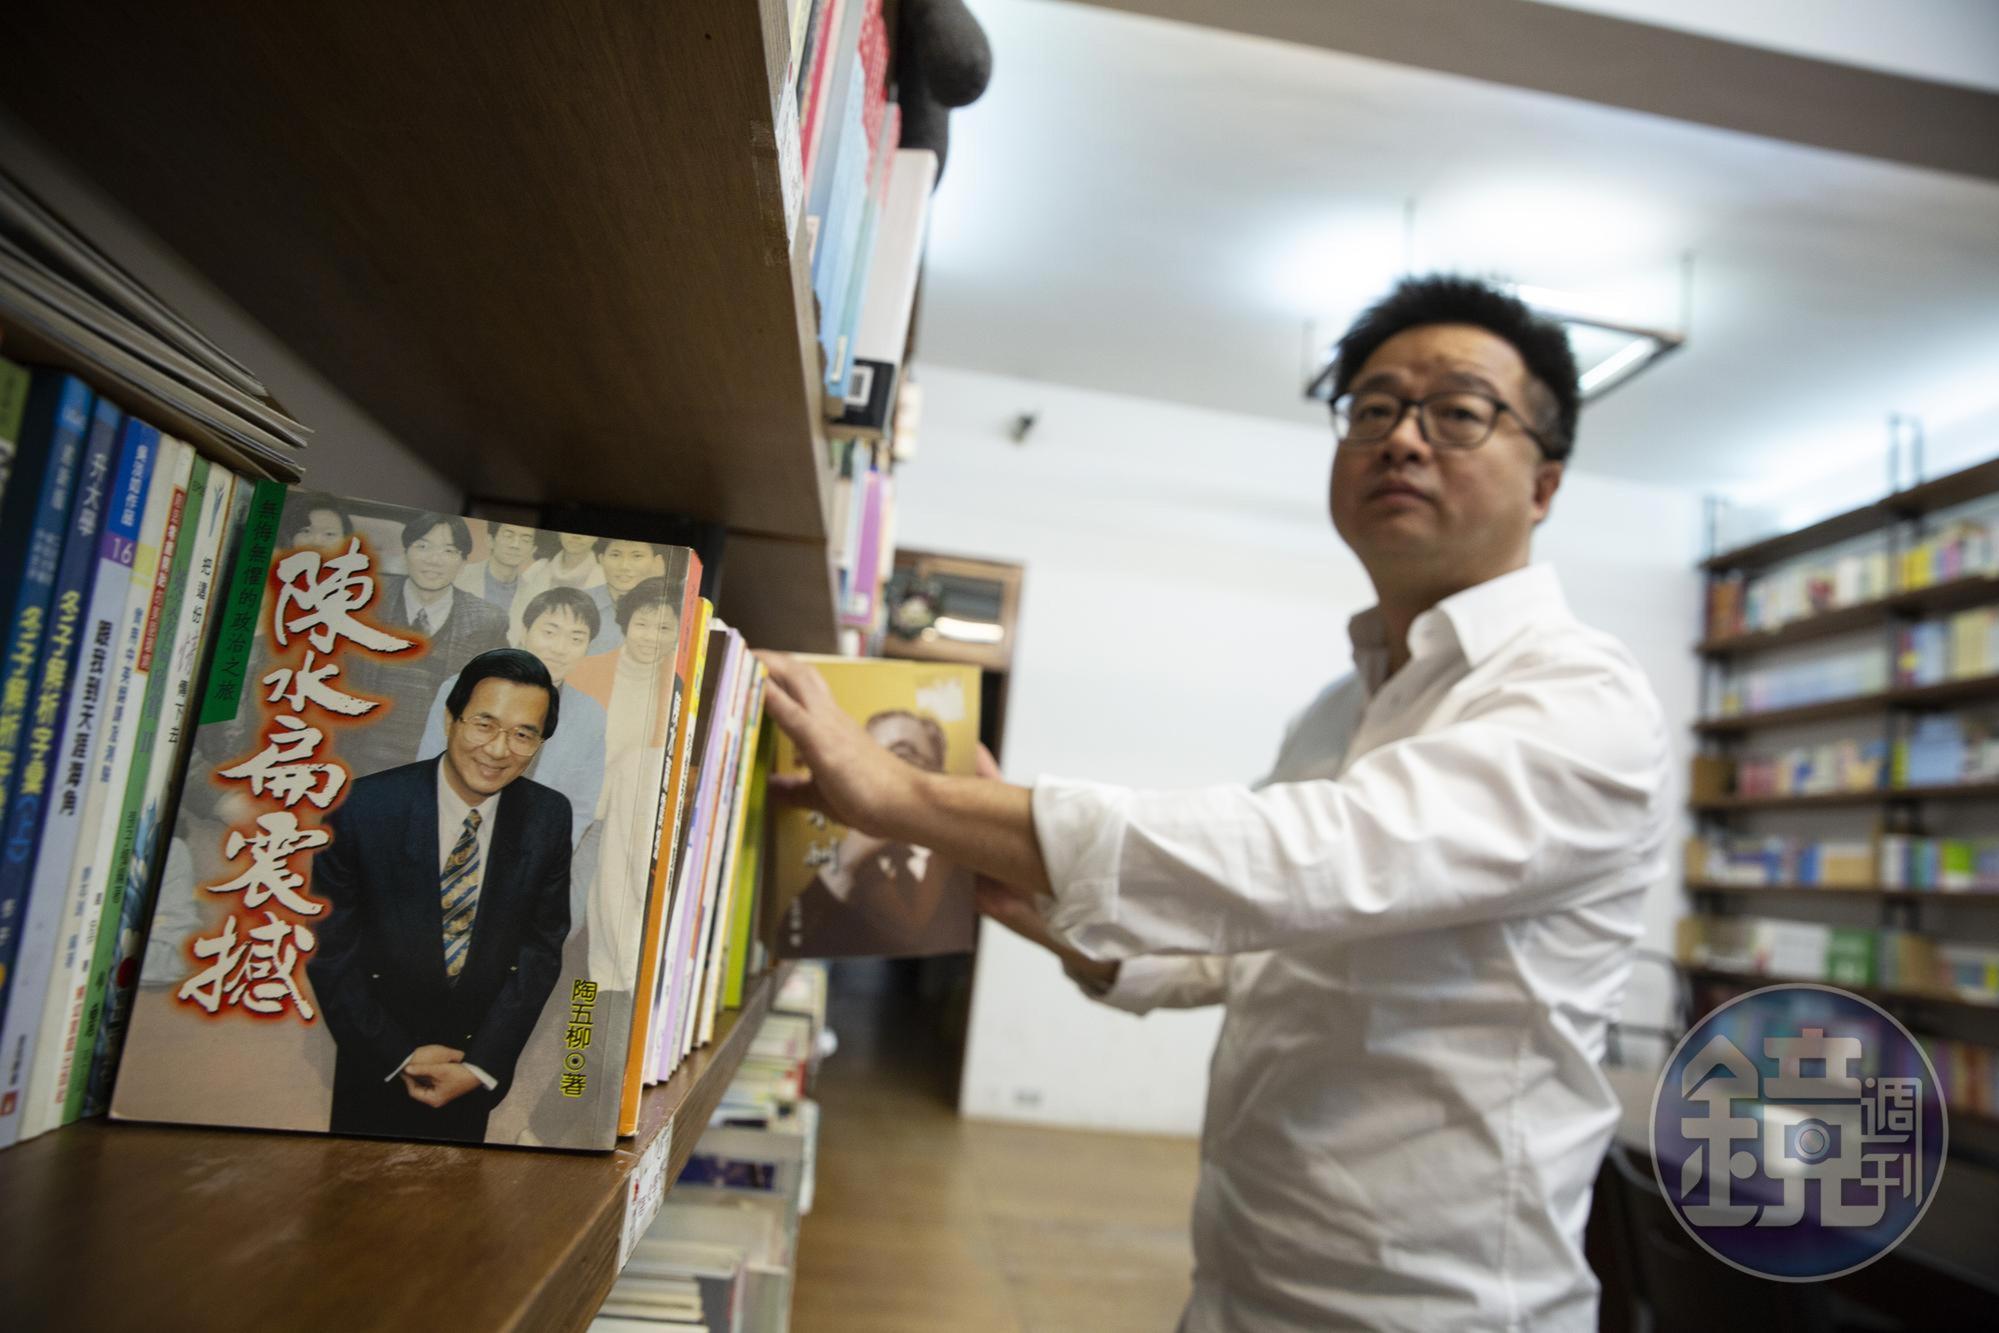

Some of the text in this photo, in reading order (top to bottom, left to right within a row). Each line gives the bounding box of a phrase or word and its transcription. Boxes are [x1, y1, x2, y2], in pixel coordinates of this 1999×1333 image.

[110, 540, 133, 566] 16
[213, 498, 281, 702] 無悔無懼的政治之旅
[179, 537, 414, 1021] 陳水扁震撼
